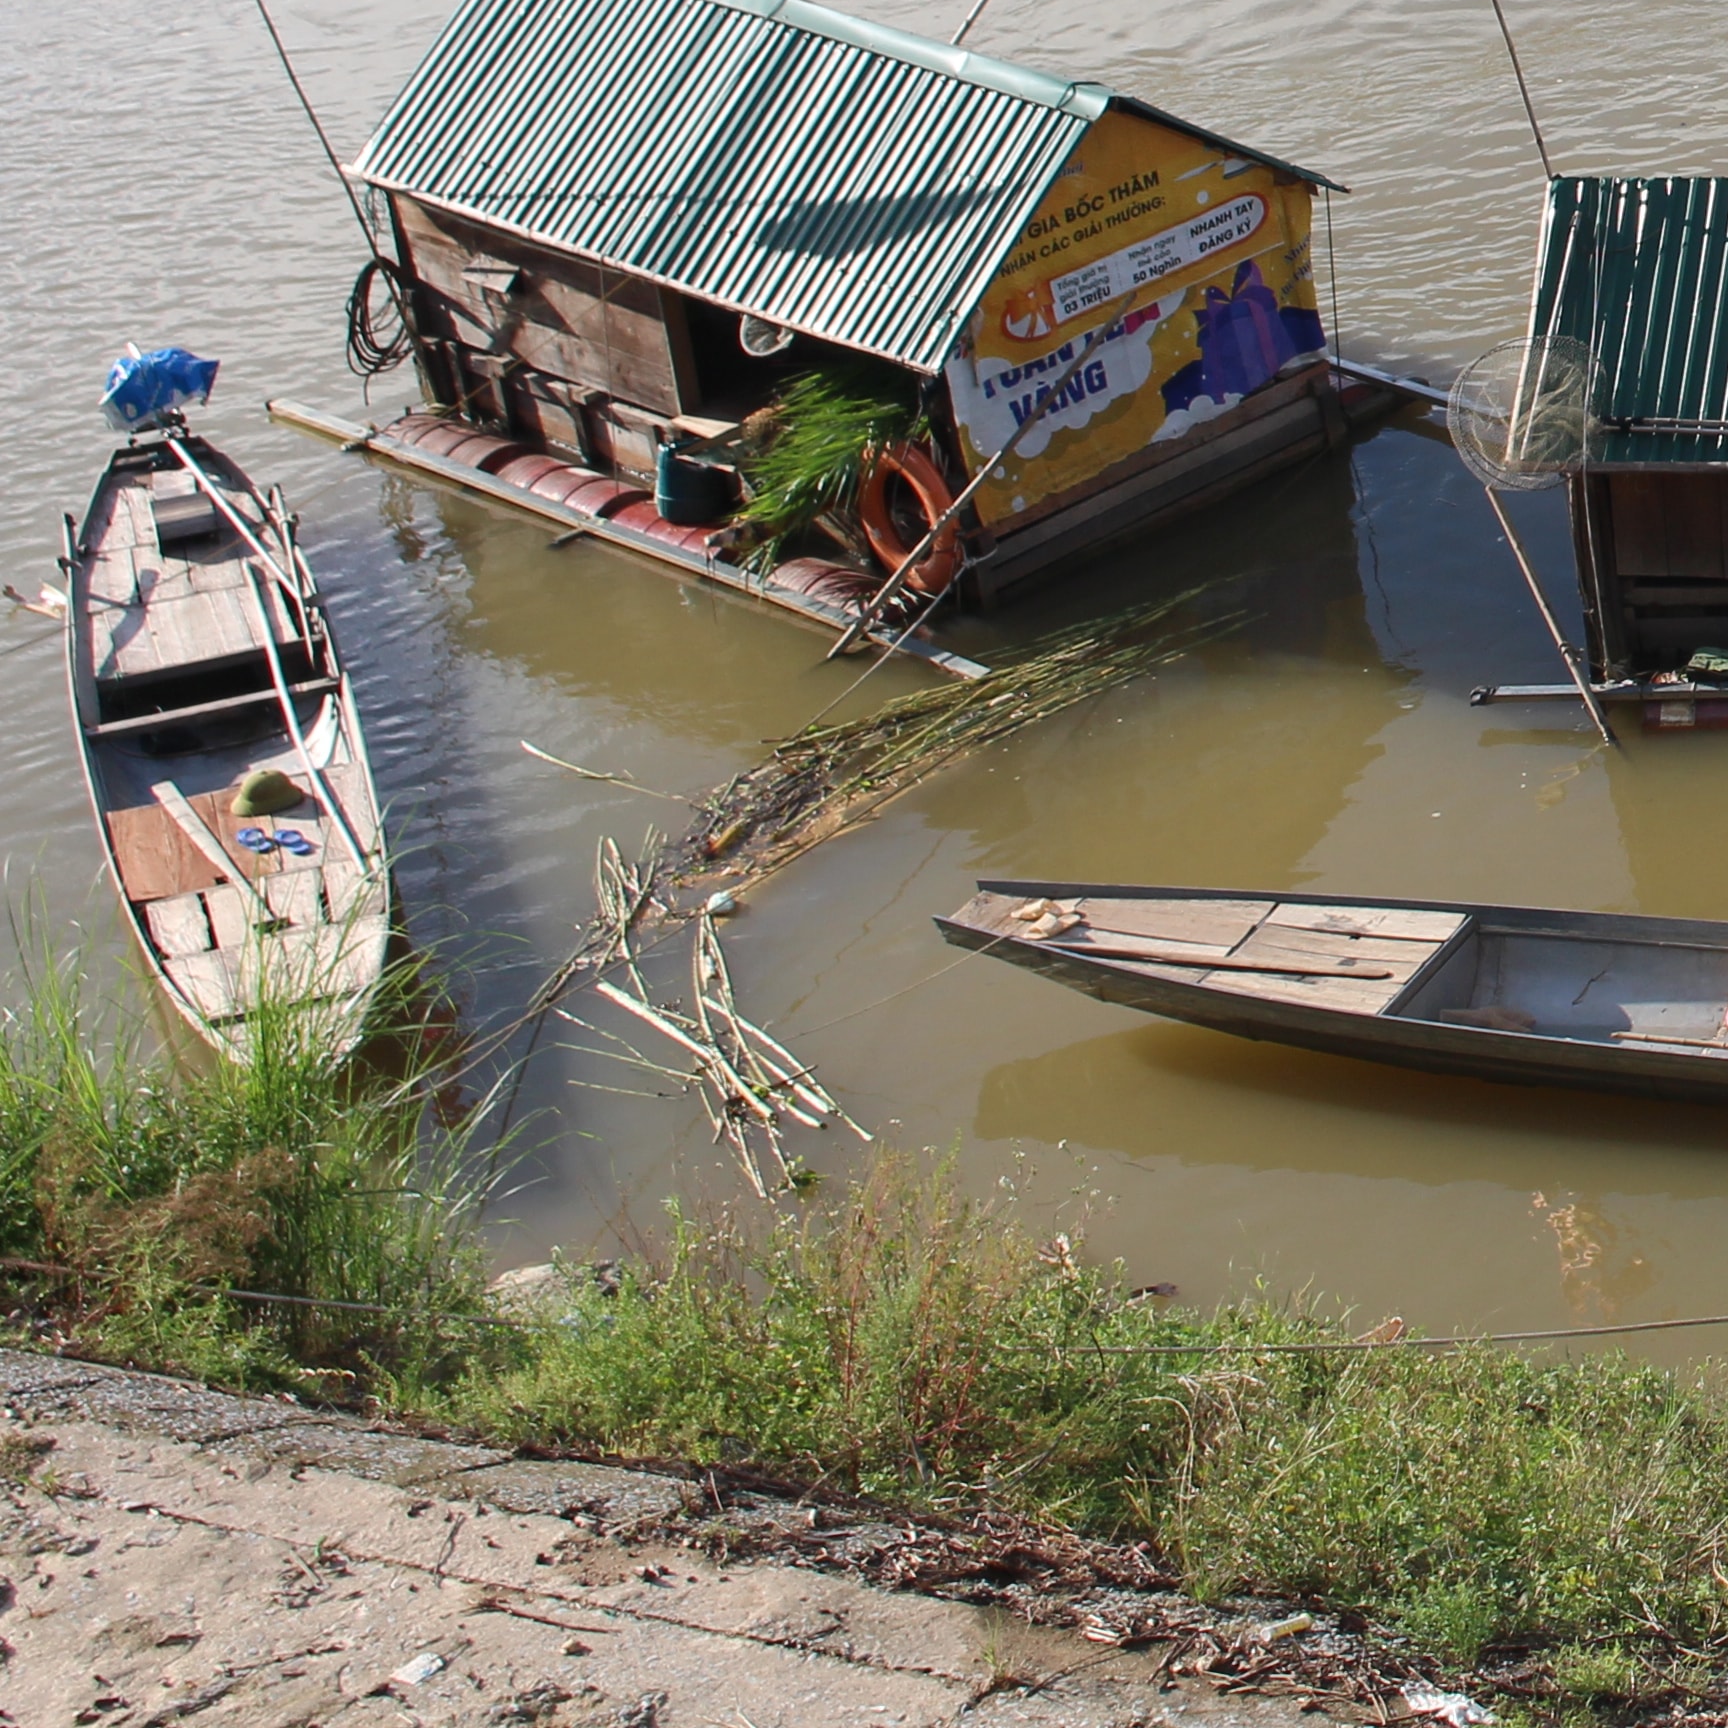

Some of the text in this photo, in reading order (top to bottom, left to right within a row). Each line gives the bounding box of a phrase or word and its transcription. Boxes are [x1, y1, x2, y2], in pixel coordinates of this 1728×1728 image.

[1027, 170, 1160, 238] GIA BỐC THĂM
[1189, 199, 1255, 239] NHANH TAY
[1040, 236, 1072, 258] CÁC
[1073, 221, 1103, 243] GIẢI
[1198, 226, 1234, 254] ĐĂNG
[1132, 255, 1182, 284] 50 Nghìn
[1064, 285, 1112, 315] 03 TRIỆU
[1009, 360, 1108, 428] VÀNG
